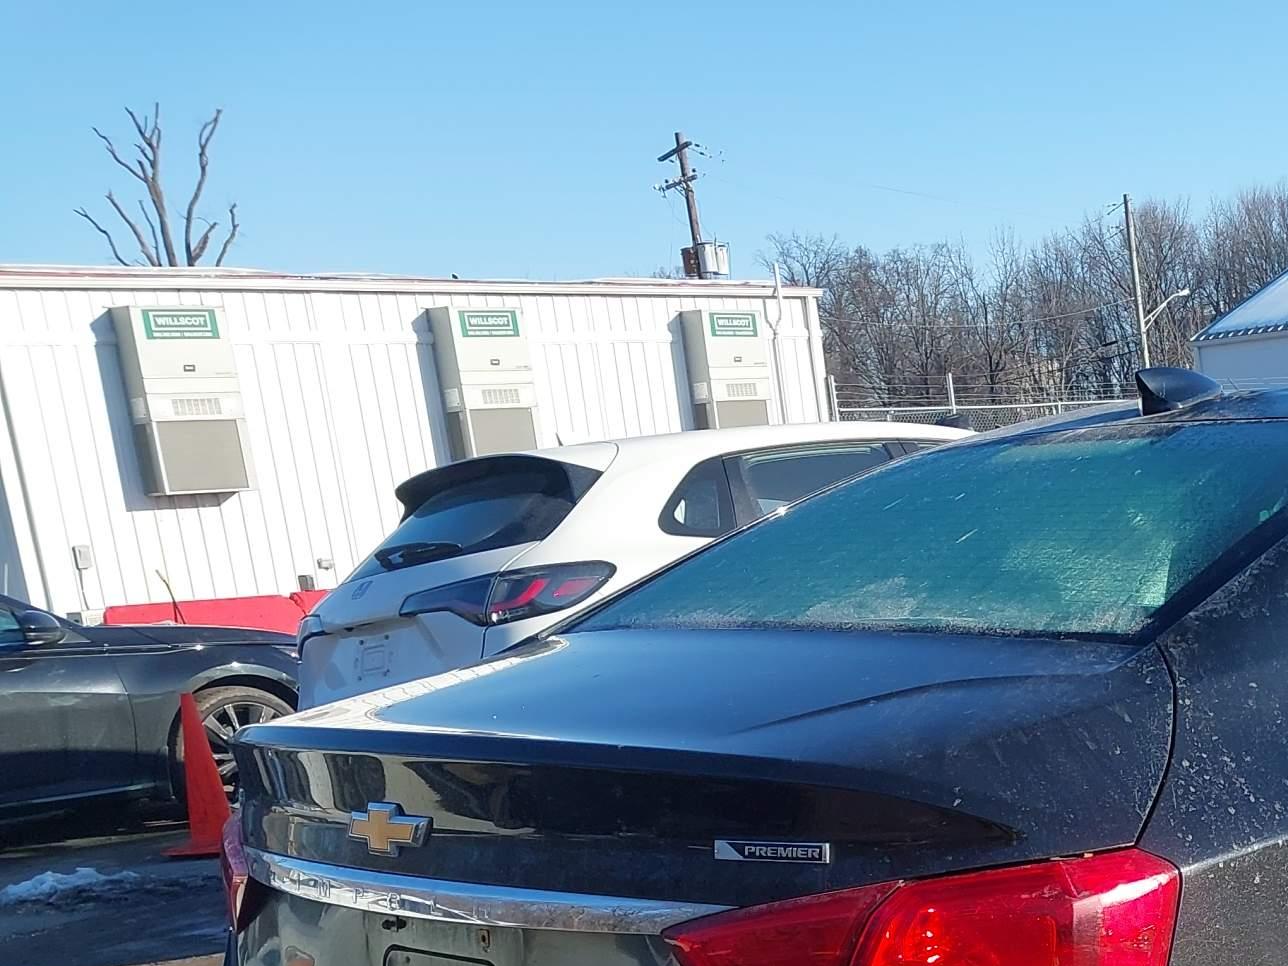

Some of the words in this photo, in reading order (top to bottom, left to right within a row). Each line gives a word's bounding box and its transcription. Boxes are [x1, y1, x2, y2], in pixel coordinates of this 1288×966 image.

[154, 316, 206, 326] WILLSCOT
[468, 316, 509, 325] WILLSCOT
[744, 845, 820, 859] PREMIER
